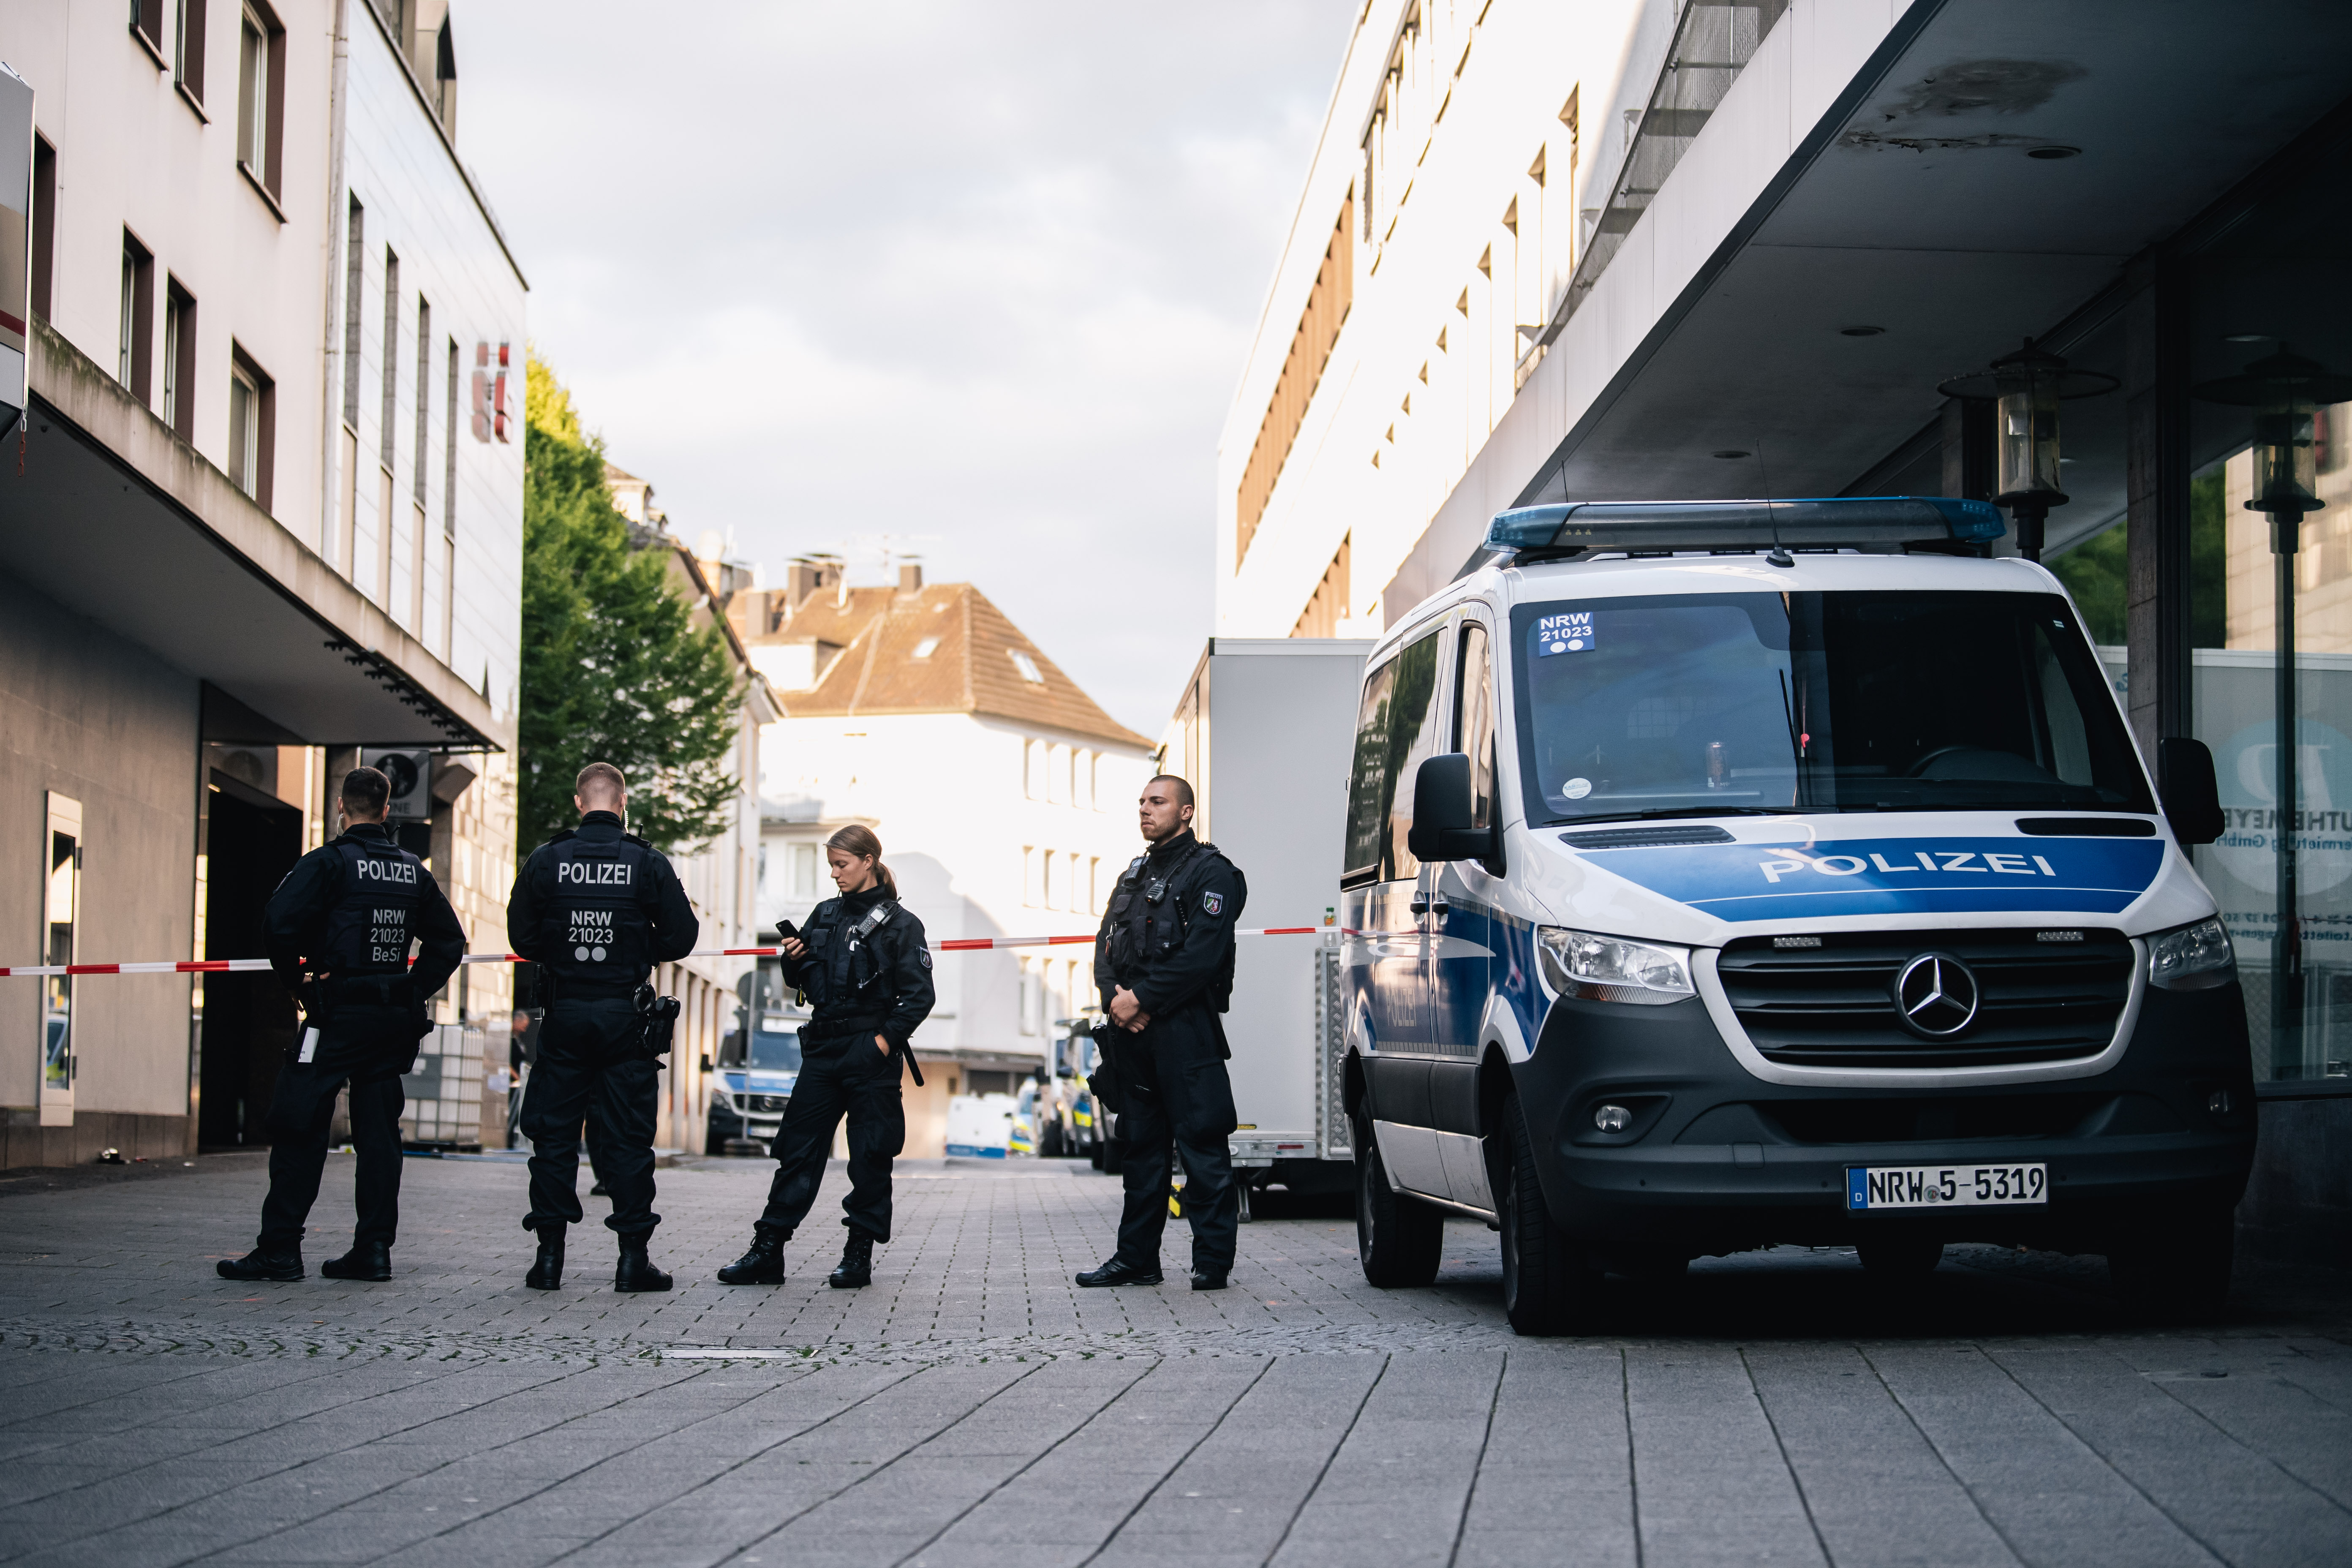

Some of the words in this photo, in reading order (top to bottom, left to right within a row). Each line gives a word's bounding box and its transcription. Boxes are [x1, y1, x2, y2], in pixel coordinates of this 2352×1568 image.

[1541, 612, 1590, 630] NRW
[1541, 626, 1592, 642] 21023
[357, 860, 416, 884] POLIZEI
[558, 863, 631, 885] POLIZEI
[1759, 852, 2056, 883] POLIZEI
[373, 909, 406, 924] NRW
[572, 910, 612, 926] NRW
[370, 928, 405, 943] 21023
[569, 927, 613, 944] 21023
[373, 947, 400, 962] BeSi
[1386, 988, 1417, 1028] POLIZEI
[1855, 1192, 1862, 1202] D
[1868, 1171, 1923, 1203] NRW
[1940, 1168, 2044, 1200] 5-5319
